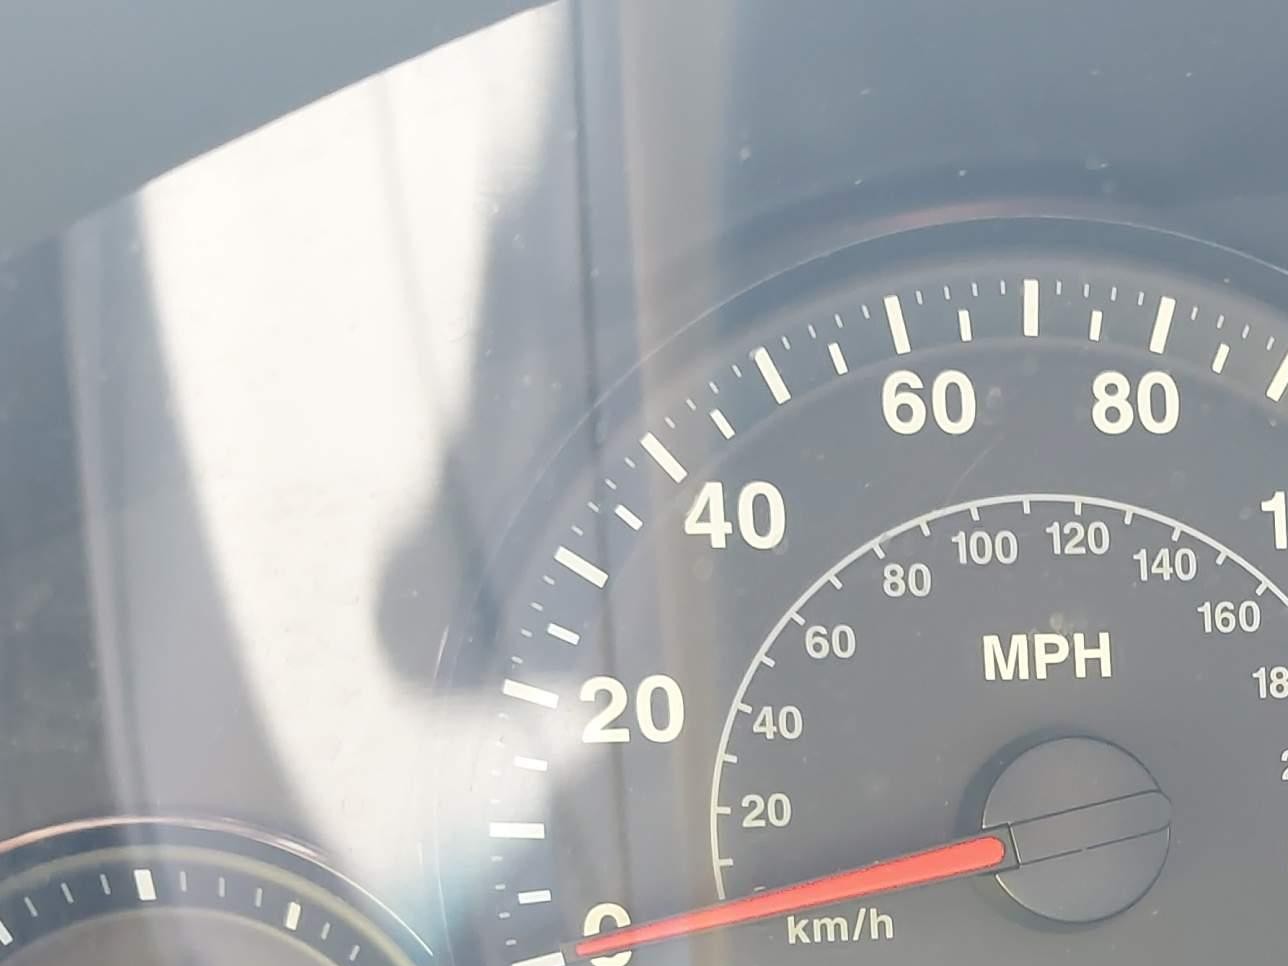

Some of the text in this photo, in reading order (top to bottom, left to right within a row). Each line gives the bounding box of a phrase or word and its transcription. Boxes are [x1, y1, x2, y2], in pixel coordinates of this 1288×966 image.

[882, 370, 977, 434] 60
[1091, 370, 1180, 434] 80
[684, 481, 787, 549] 40
[951, 530, 1018, 565] 100
[1045, 521, 1110, 555] 120
[882, 563, 932, 598] 80
[1133, 547, 1198, 582] 140
[1197, 600, 1261, 633] 160
[804, 624, 856, 659] 60
[983, 632, 1112, 681] MPH
[579, 674, 685, 743] 20
[752, 705, 803, 740] 40
[741, 793, 792, 828] 20
[786, 907, 894, 944] km/h
